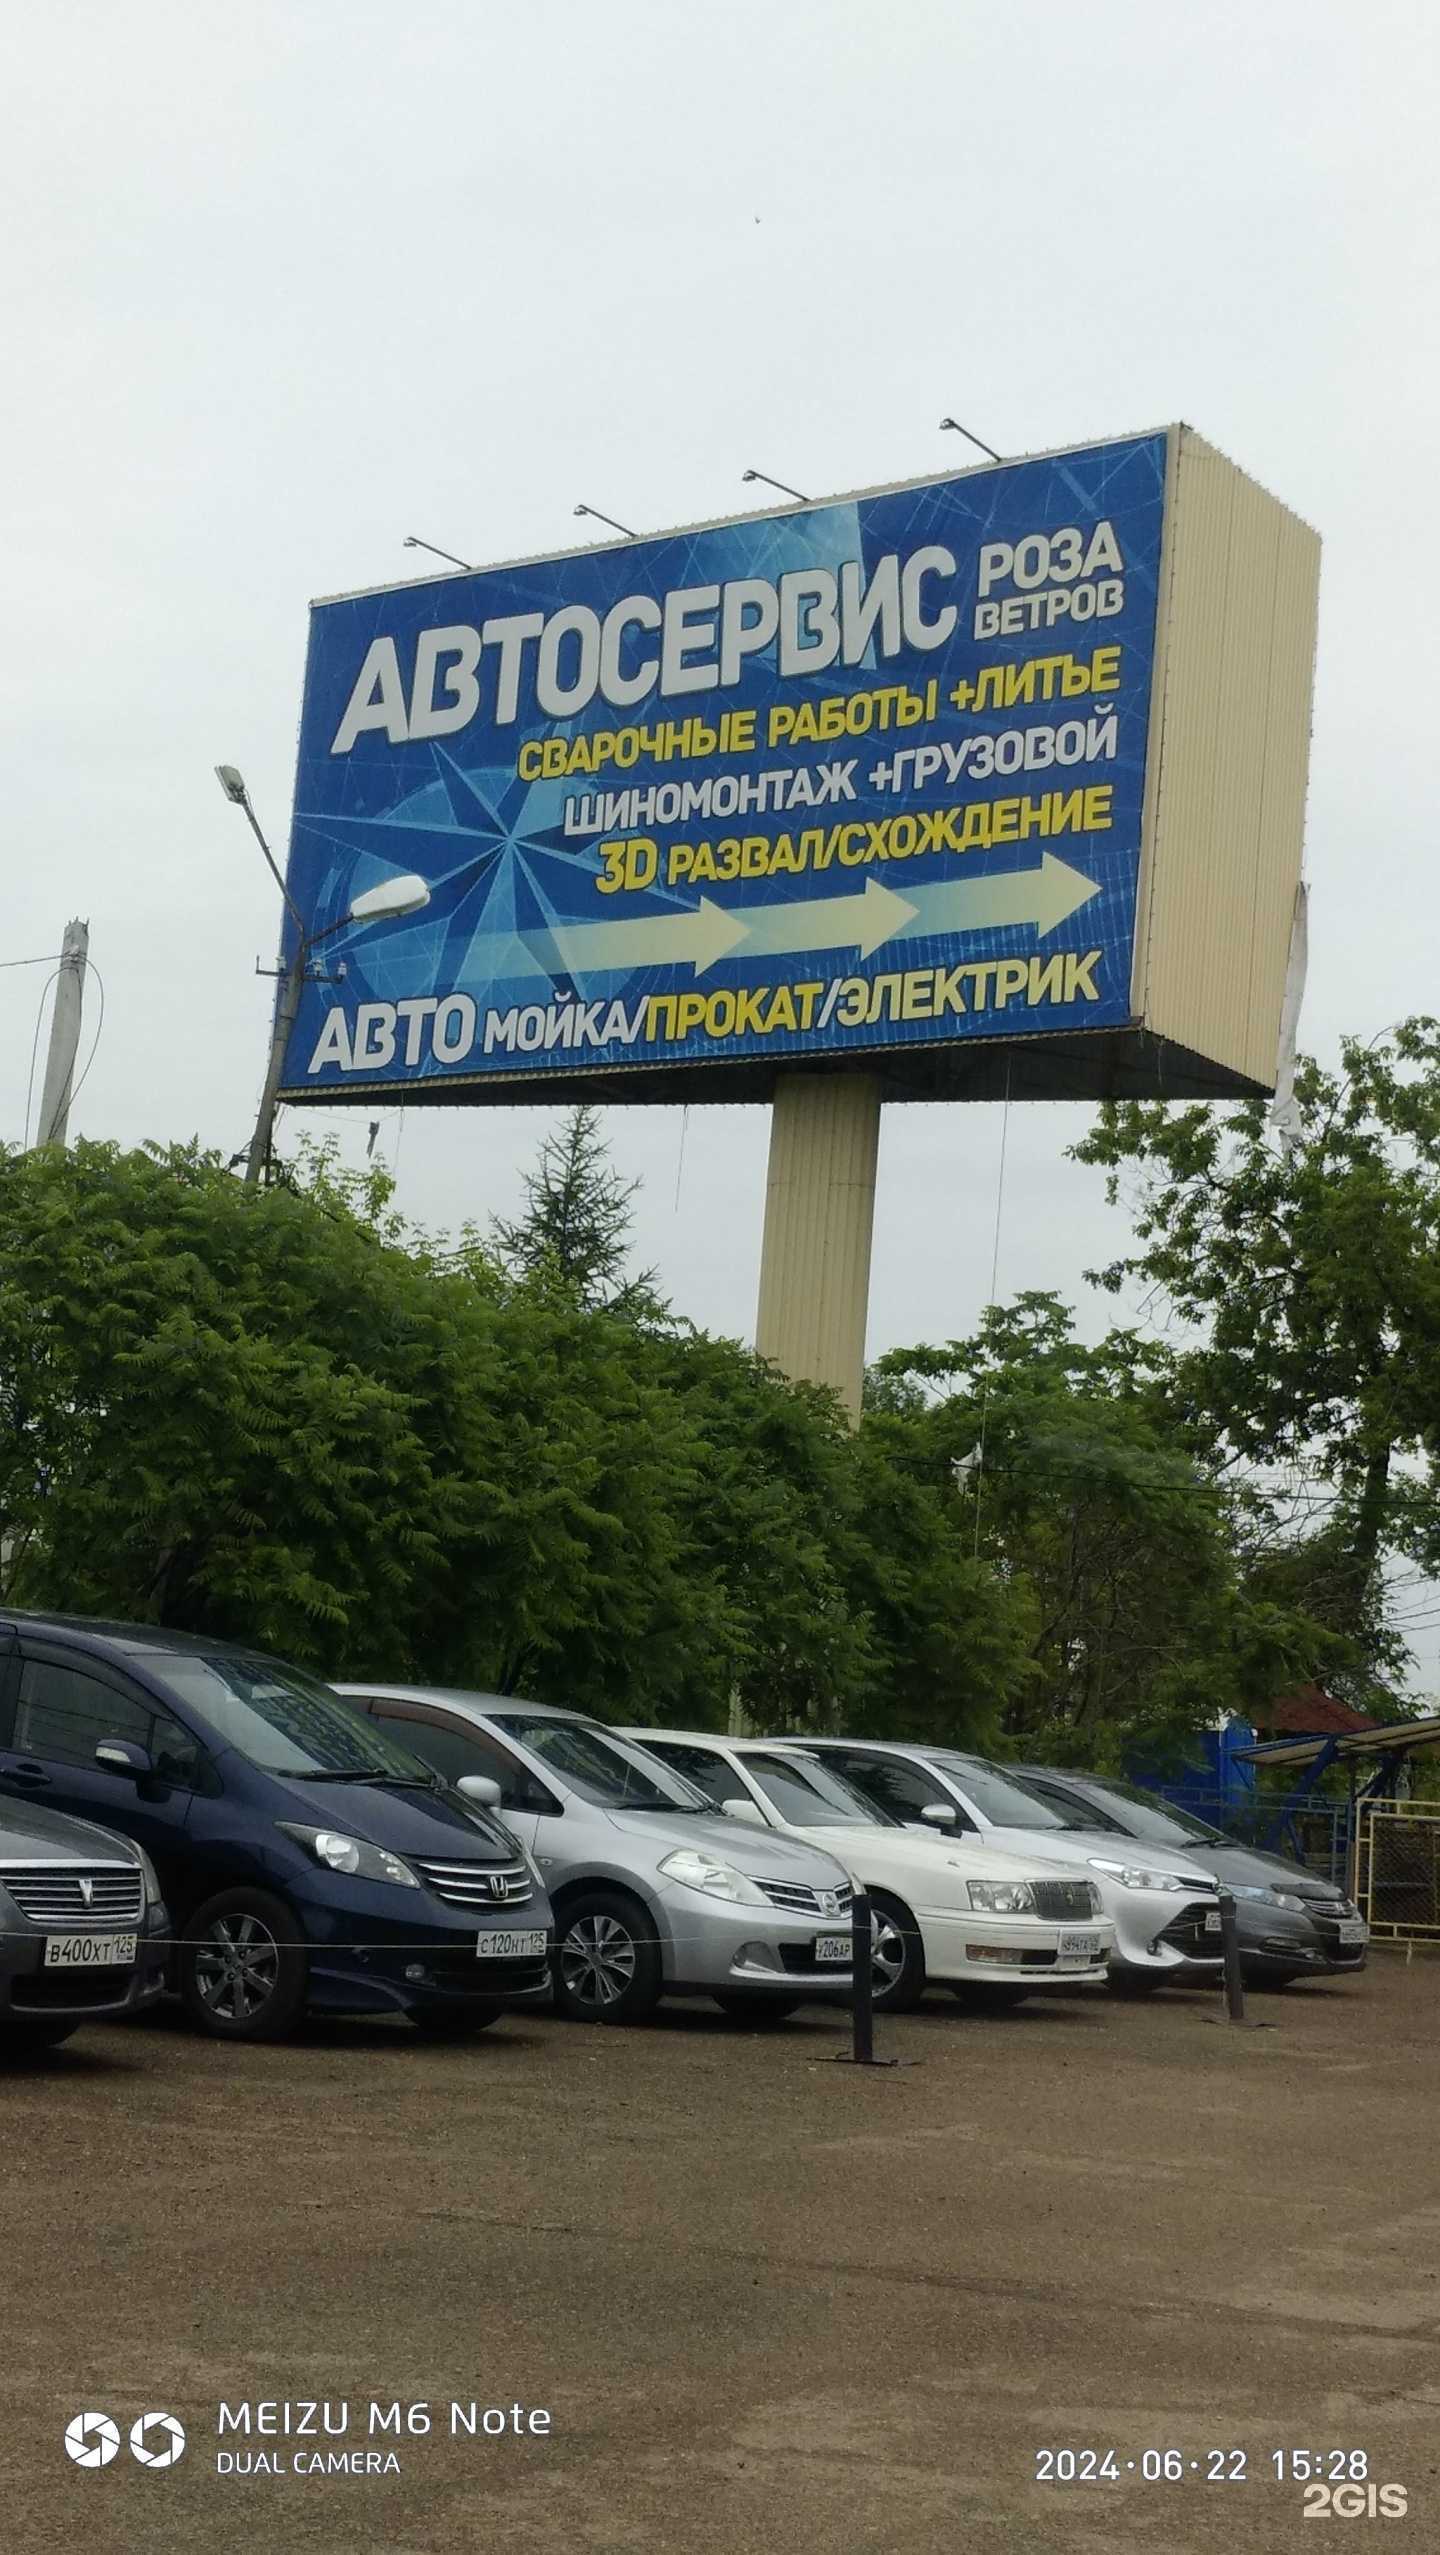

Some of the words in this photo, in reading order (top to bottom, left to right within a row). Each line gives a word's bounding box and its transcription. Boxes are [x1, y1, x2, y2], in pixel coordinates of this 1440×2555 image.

[974, 579, 1124, 640] ВЕТРОВ
[978, 521, 1124, 597] РОЗА
[330, 545, 957, 754] АВТОСЕРВИС
[519, 710, 756, 781] СВАРОЧНЫЕ
[768, 679, 938, 748] РАБОТЫ
[950, 646, 1122, 714] +ЛИТЬЕ
[563, 758, 858, 837] ШИНОМОНТАЖ
[869, 702, 1118, 793] +ГРУЗОВОЙ
[596, 837, 660, 894] 3D
[668, 785, 1113, 885] РАЗВАЛ/СХОЖДЕНИЕ
[307, 993, 477, 1075] АВТО
[483, 951, 1103, 1054] МОЙКА/ПРОКАТ/ЭЛЕКТРИК
[50, 1938, 111, 1962] В400ХТ
